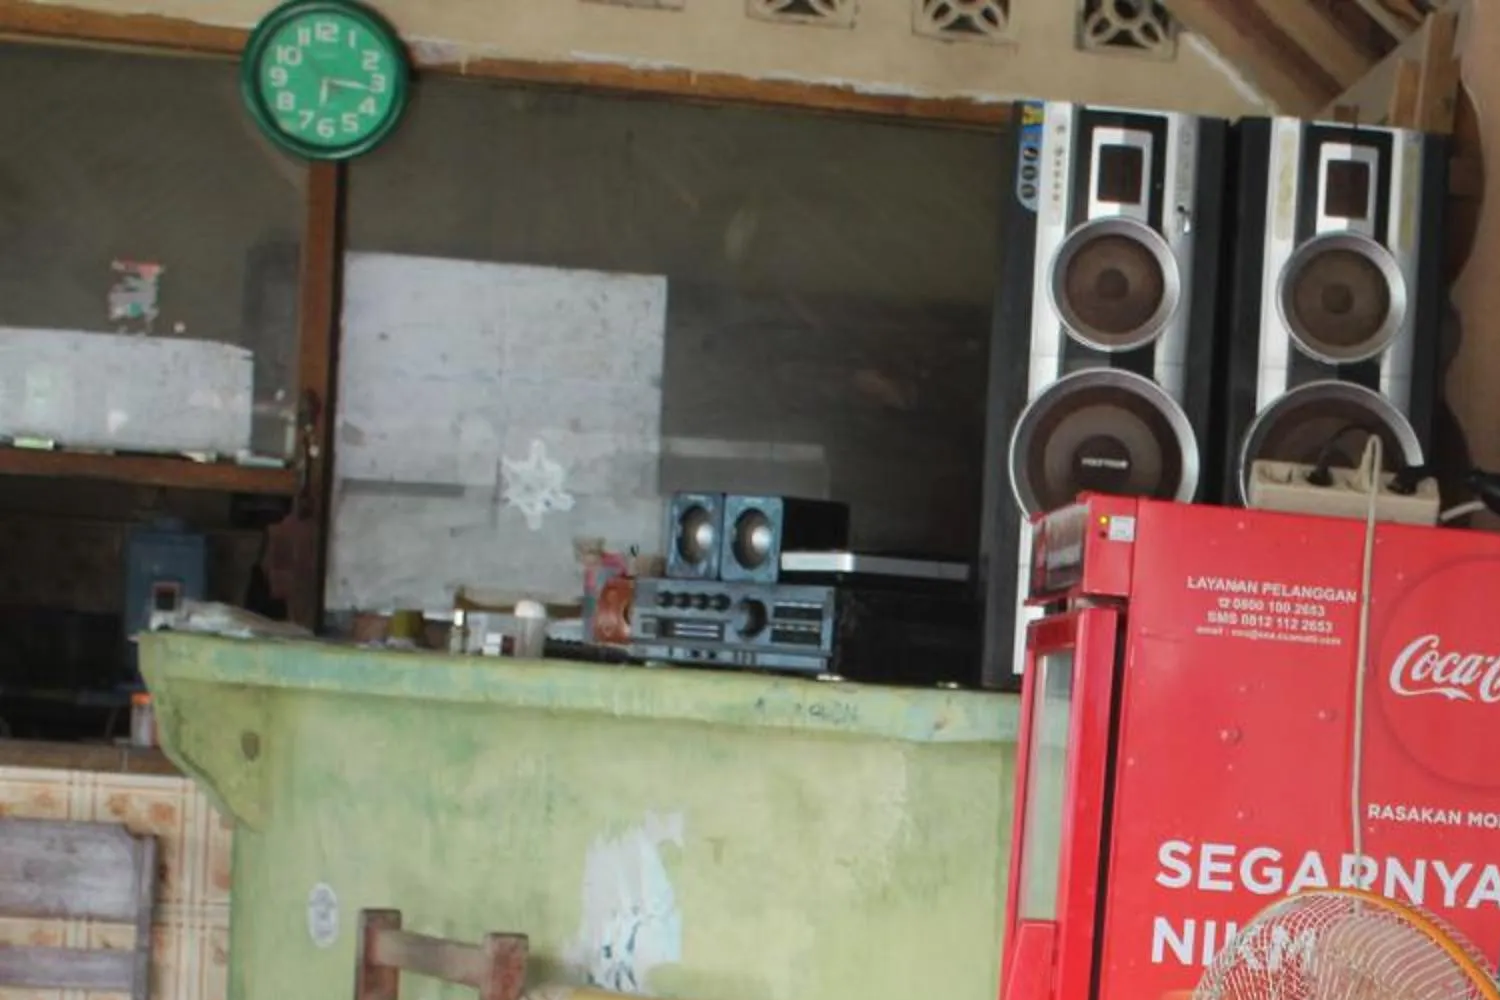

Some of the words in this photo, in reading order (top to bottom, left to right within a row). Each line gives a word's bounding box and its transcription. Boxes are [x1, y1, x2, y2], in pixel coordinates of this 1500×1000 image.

[297, 27, 310, 46] 11
[315, 22, 338, 42] 12
[348, 29, 356, 48] 1
[276, 45, 302, 65] 10
[361, 50, 379, 70] 2
[269, 67, 288, 88] 9
[369, 73, 385, 93] 3
[276, 92, 295, 111] 8
[359, 97, 377, 115] 4
[299, 111, 314, 130] 7
[316, 118, 335, 138] 6
[342, 113, 359, 132] 5
[1187, 575, 1258, 594] LAYANAN
[1262, 583, 1357, 603] PELANGGAN
[1367, 804, 1461, 825] RASAKAN
